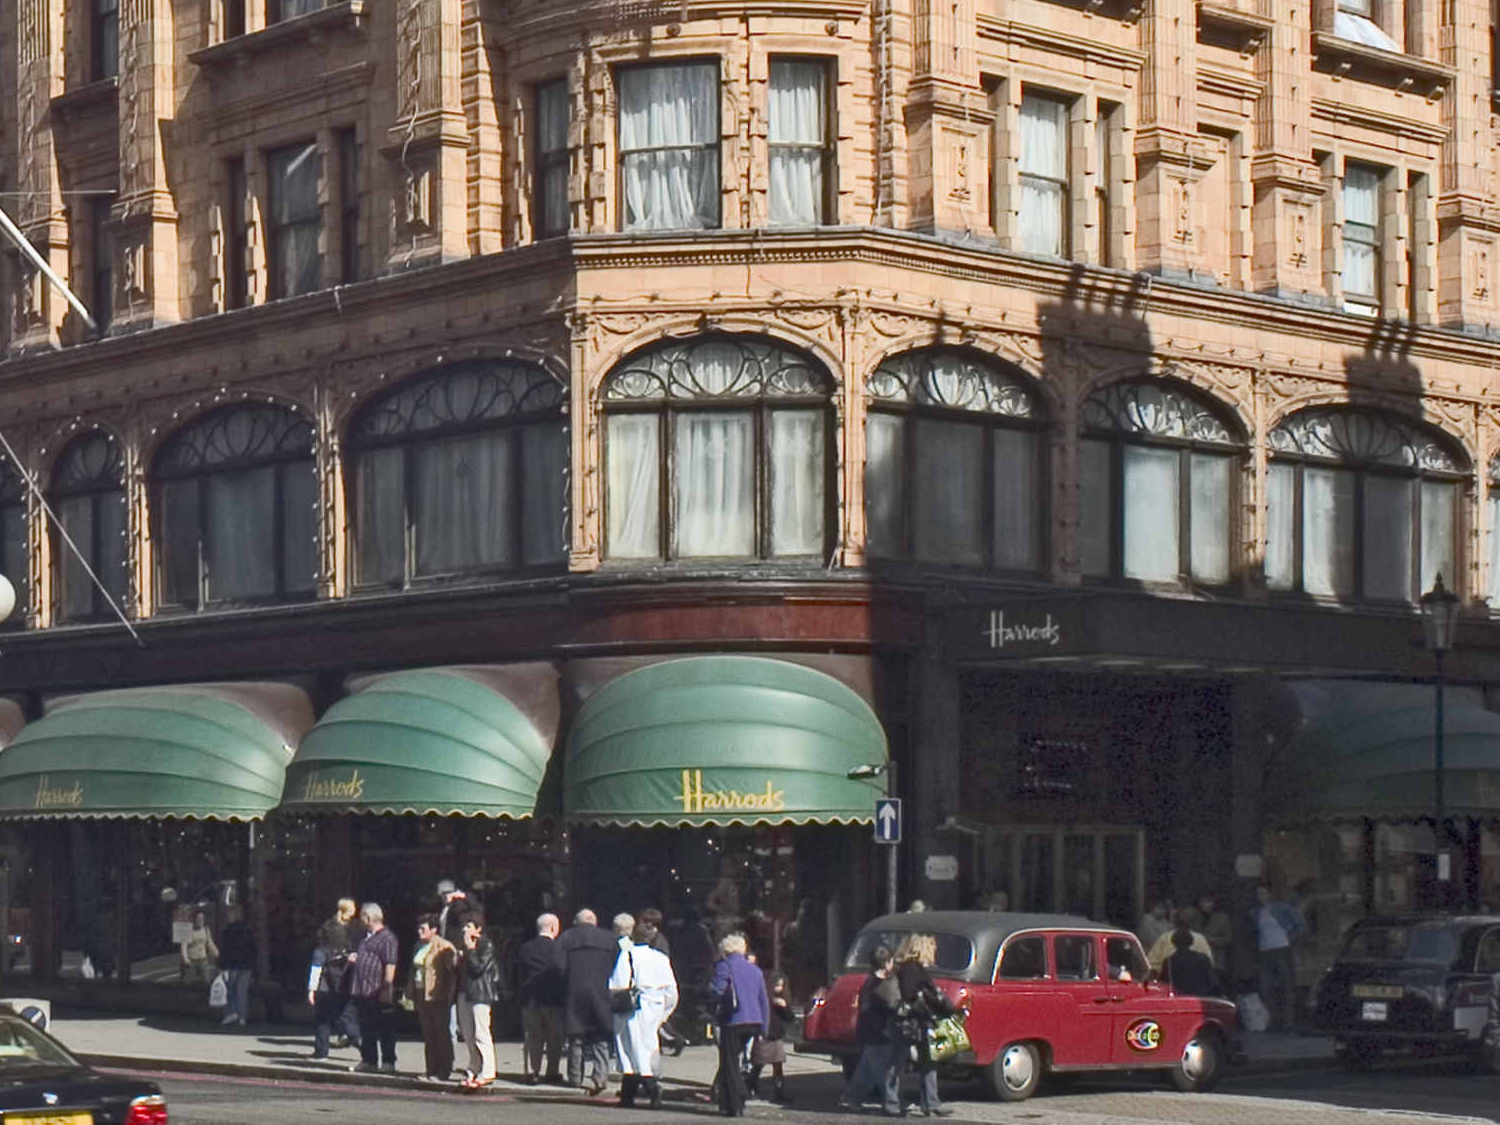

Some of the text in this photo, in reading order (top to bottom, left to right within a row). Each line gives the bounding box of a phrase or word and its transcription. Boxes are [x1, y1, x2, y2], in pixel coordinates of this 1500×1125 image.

[981, 610, 1059, 648] Harrods
[302, 769, 364, 802] Harrods
[673, 769, 785, 813] Harrods
